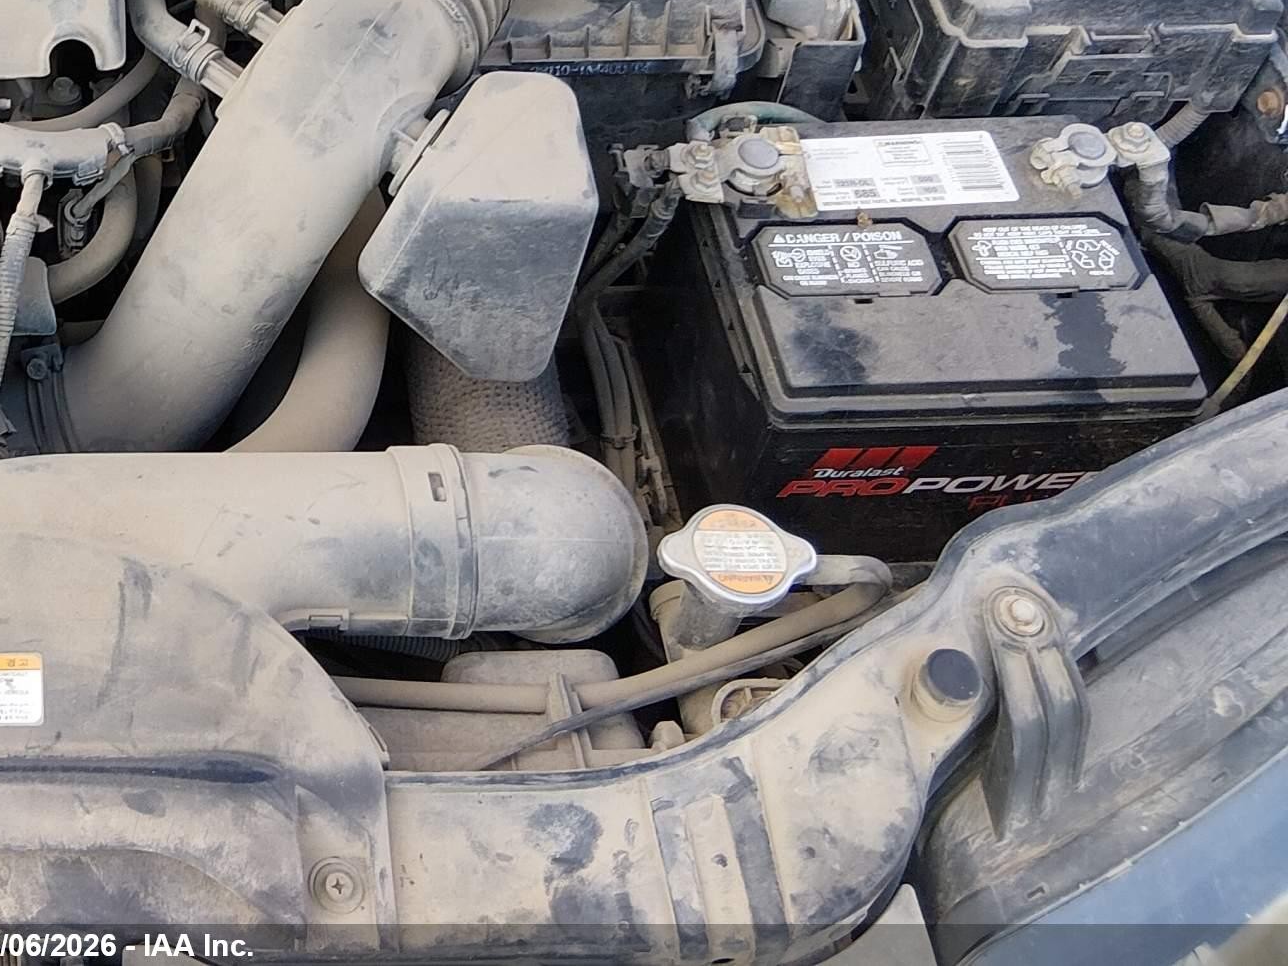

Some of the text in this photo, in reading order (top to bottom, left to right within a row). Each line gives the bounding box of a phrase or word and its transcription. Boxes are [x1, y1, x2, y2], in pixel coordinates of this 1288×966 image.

[785, 233, 841, 244] DANGER
[852, 231, 903, 242] POISON
[814, 466, 904, 478] Duralast
